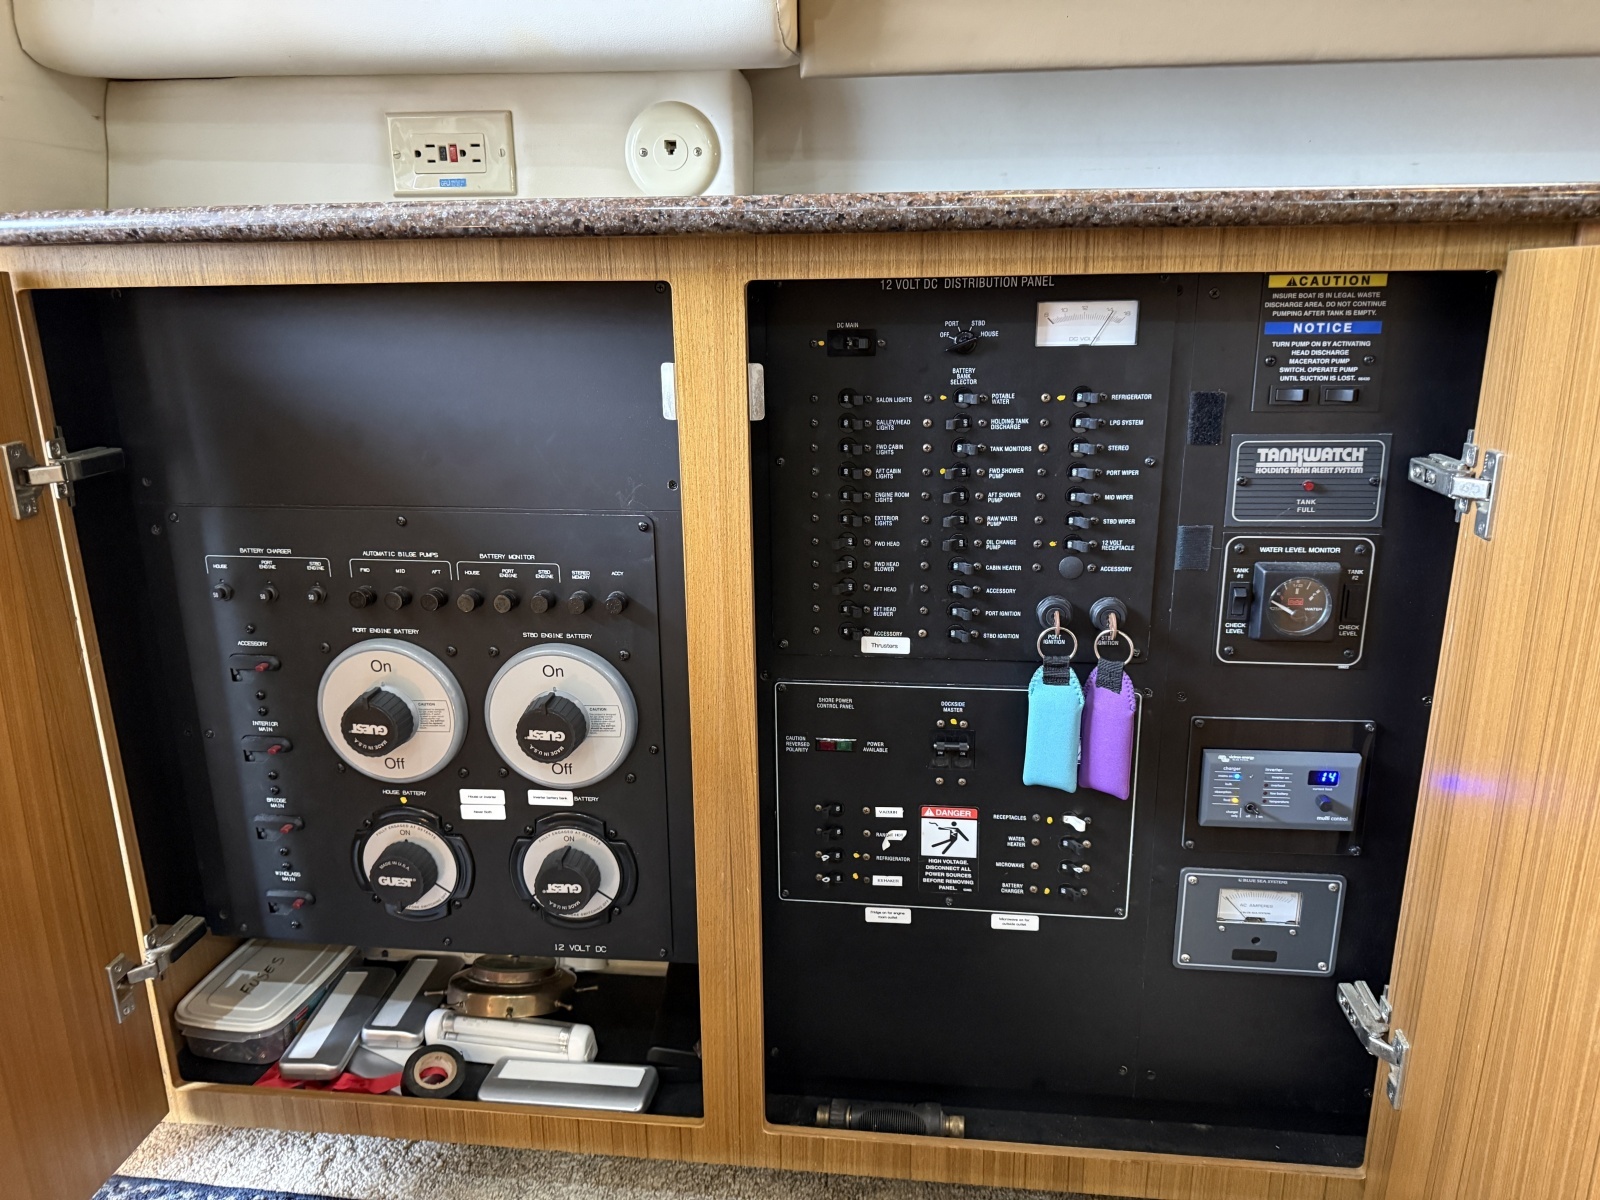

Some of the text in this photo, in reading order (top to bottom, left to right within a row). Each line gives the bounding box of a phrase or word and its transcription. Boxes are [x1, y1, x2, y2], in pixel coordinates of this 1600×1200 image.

[880, 276, 1054, 290] 12 VOLT DC DISTRIBUTION PANEL
[1300, 276, 1371, 286] CAUTION
[1293, 322, 1353, 333] NOTICE
[1257, 448, 1364, 466] TANKWATCH
[370, 659, 392, 673] On
[542, 665, 564, 678] On
[527, 730, 565, 742] GUEST
[384, 757, 405, 770] Off
[552, 762, 573, 775] Off
[1322, 773, 1336, 782] 14
[240, 957, 284, 994] FUSES
